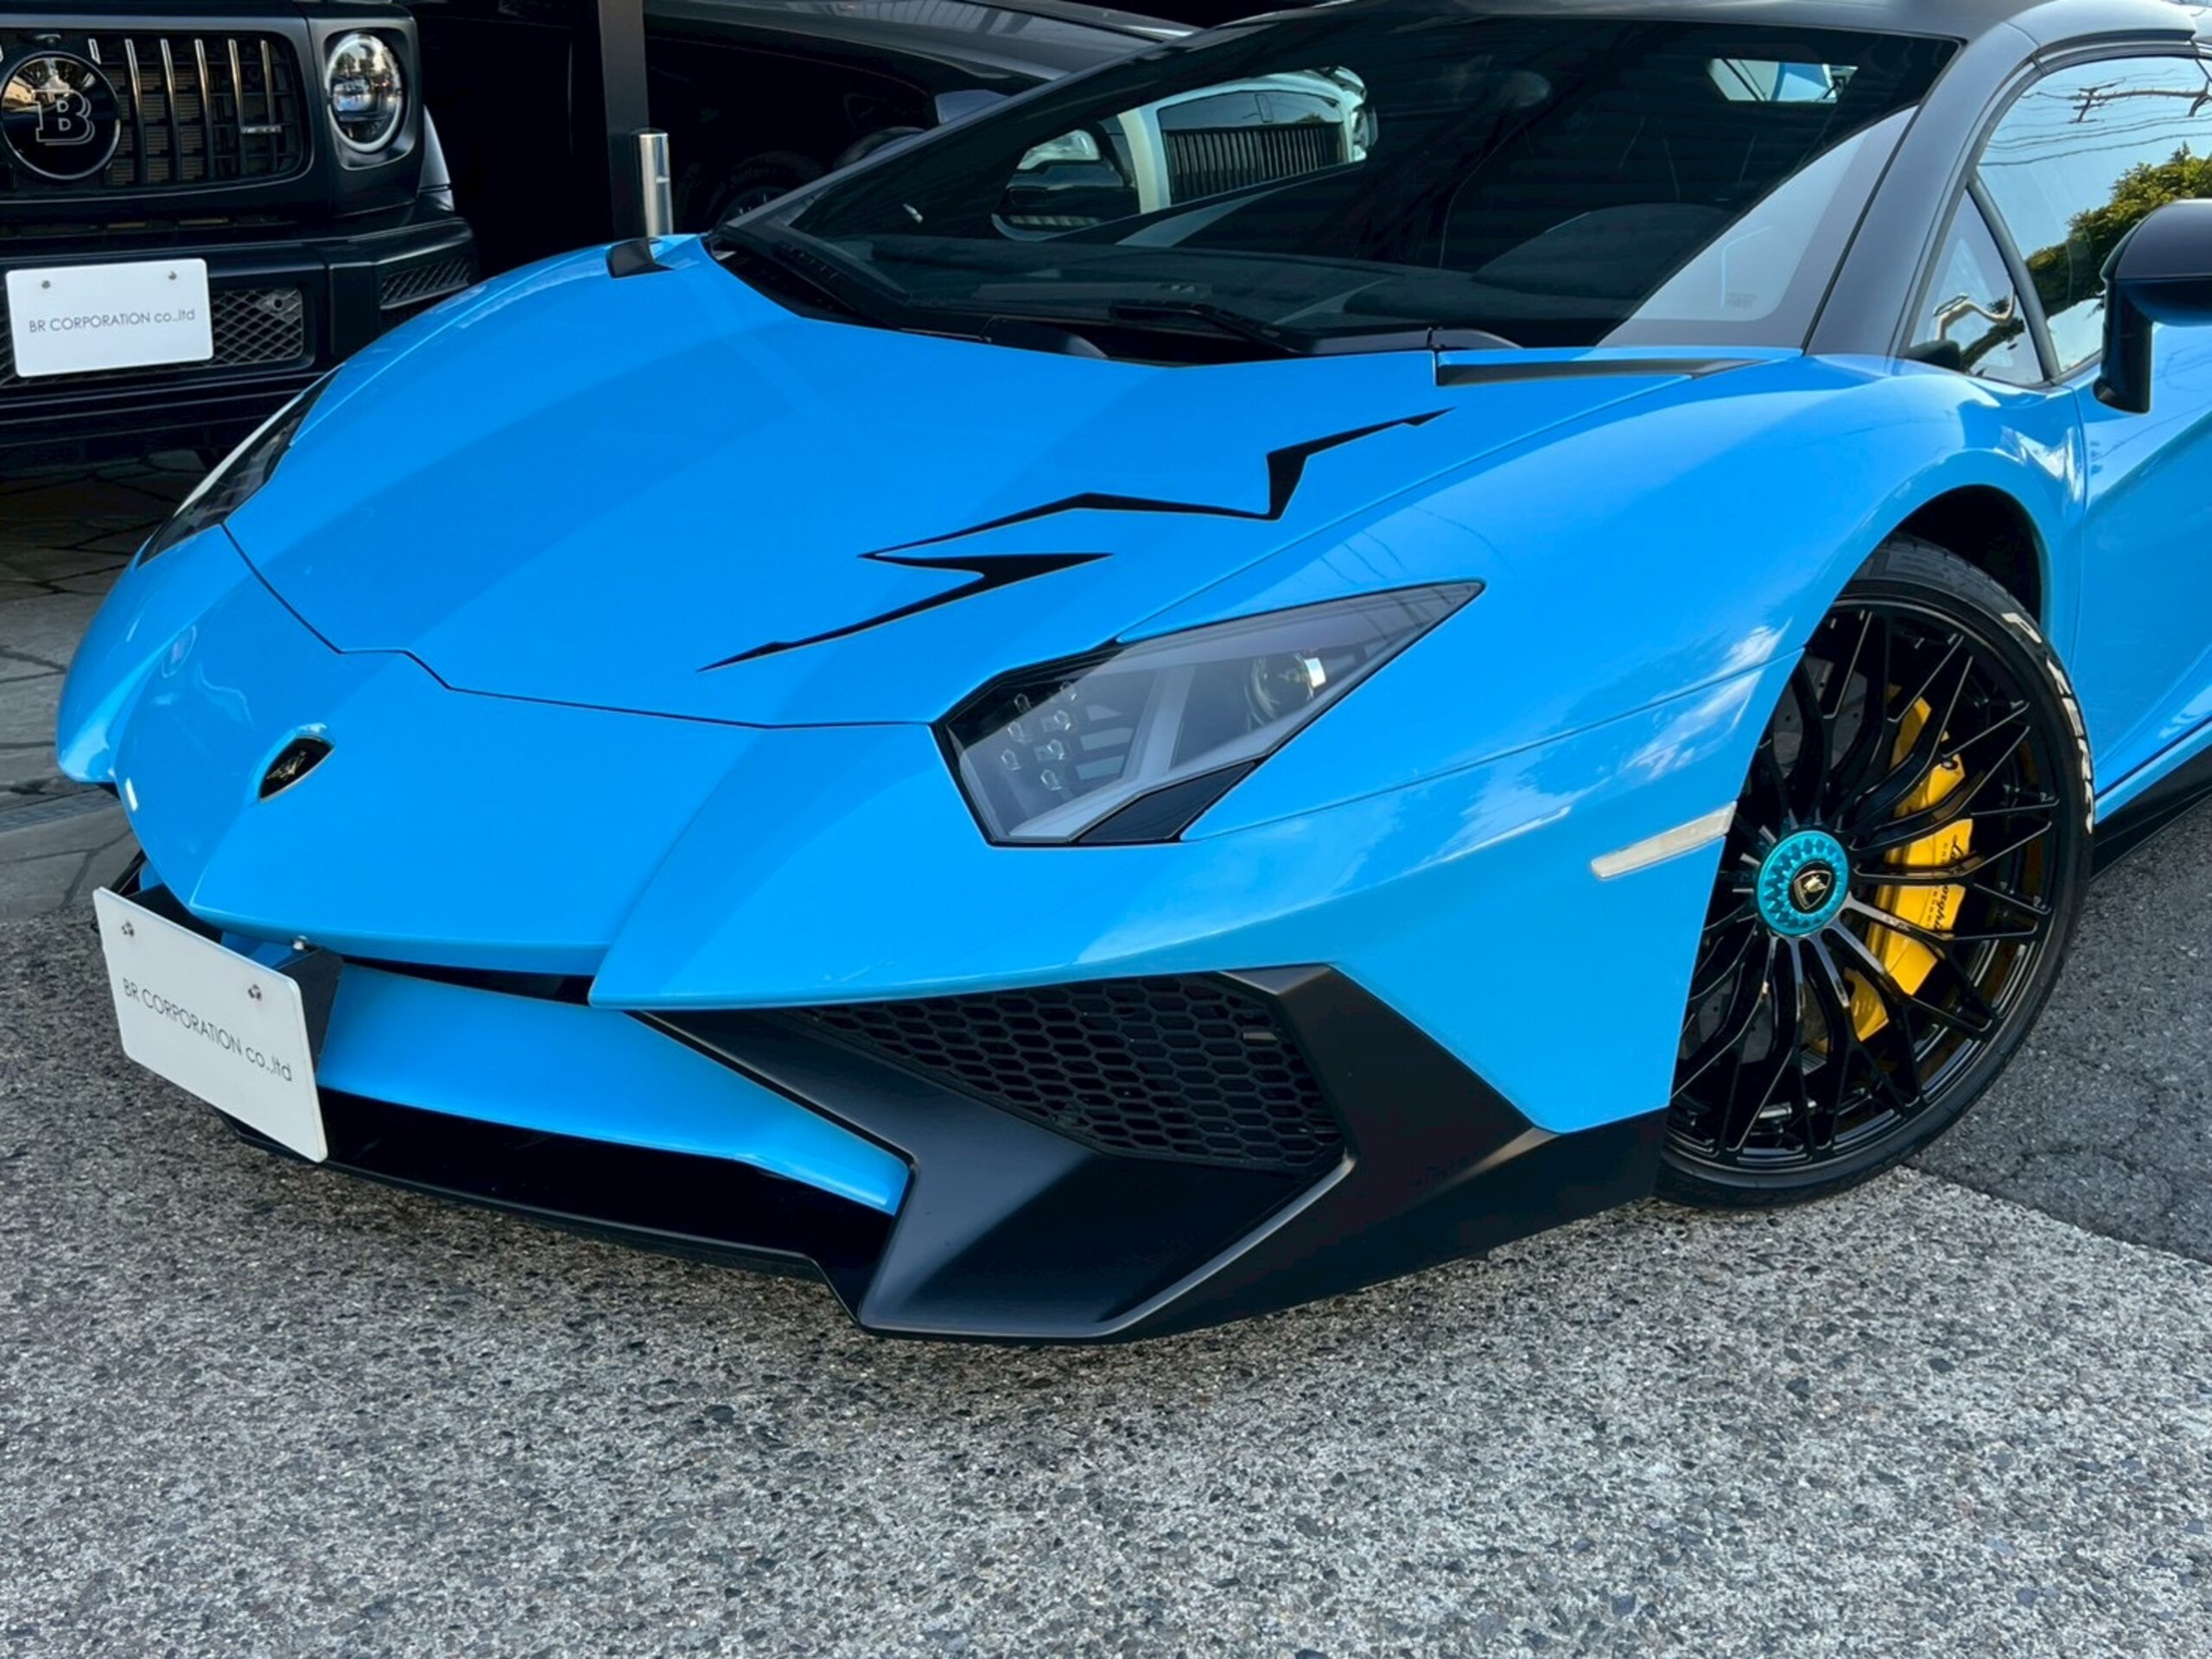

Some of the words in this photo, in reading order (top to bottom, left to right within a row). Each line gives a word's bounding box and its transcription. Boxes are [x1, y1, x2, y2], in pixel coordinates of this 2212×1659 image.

[29, 319, 47, 334] BR
[50, 311, 151, 332] CORPORATION
[123, 978, 141, 1002] BR
[141, 988, 243, 1057] CORPORATION
